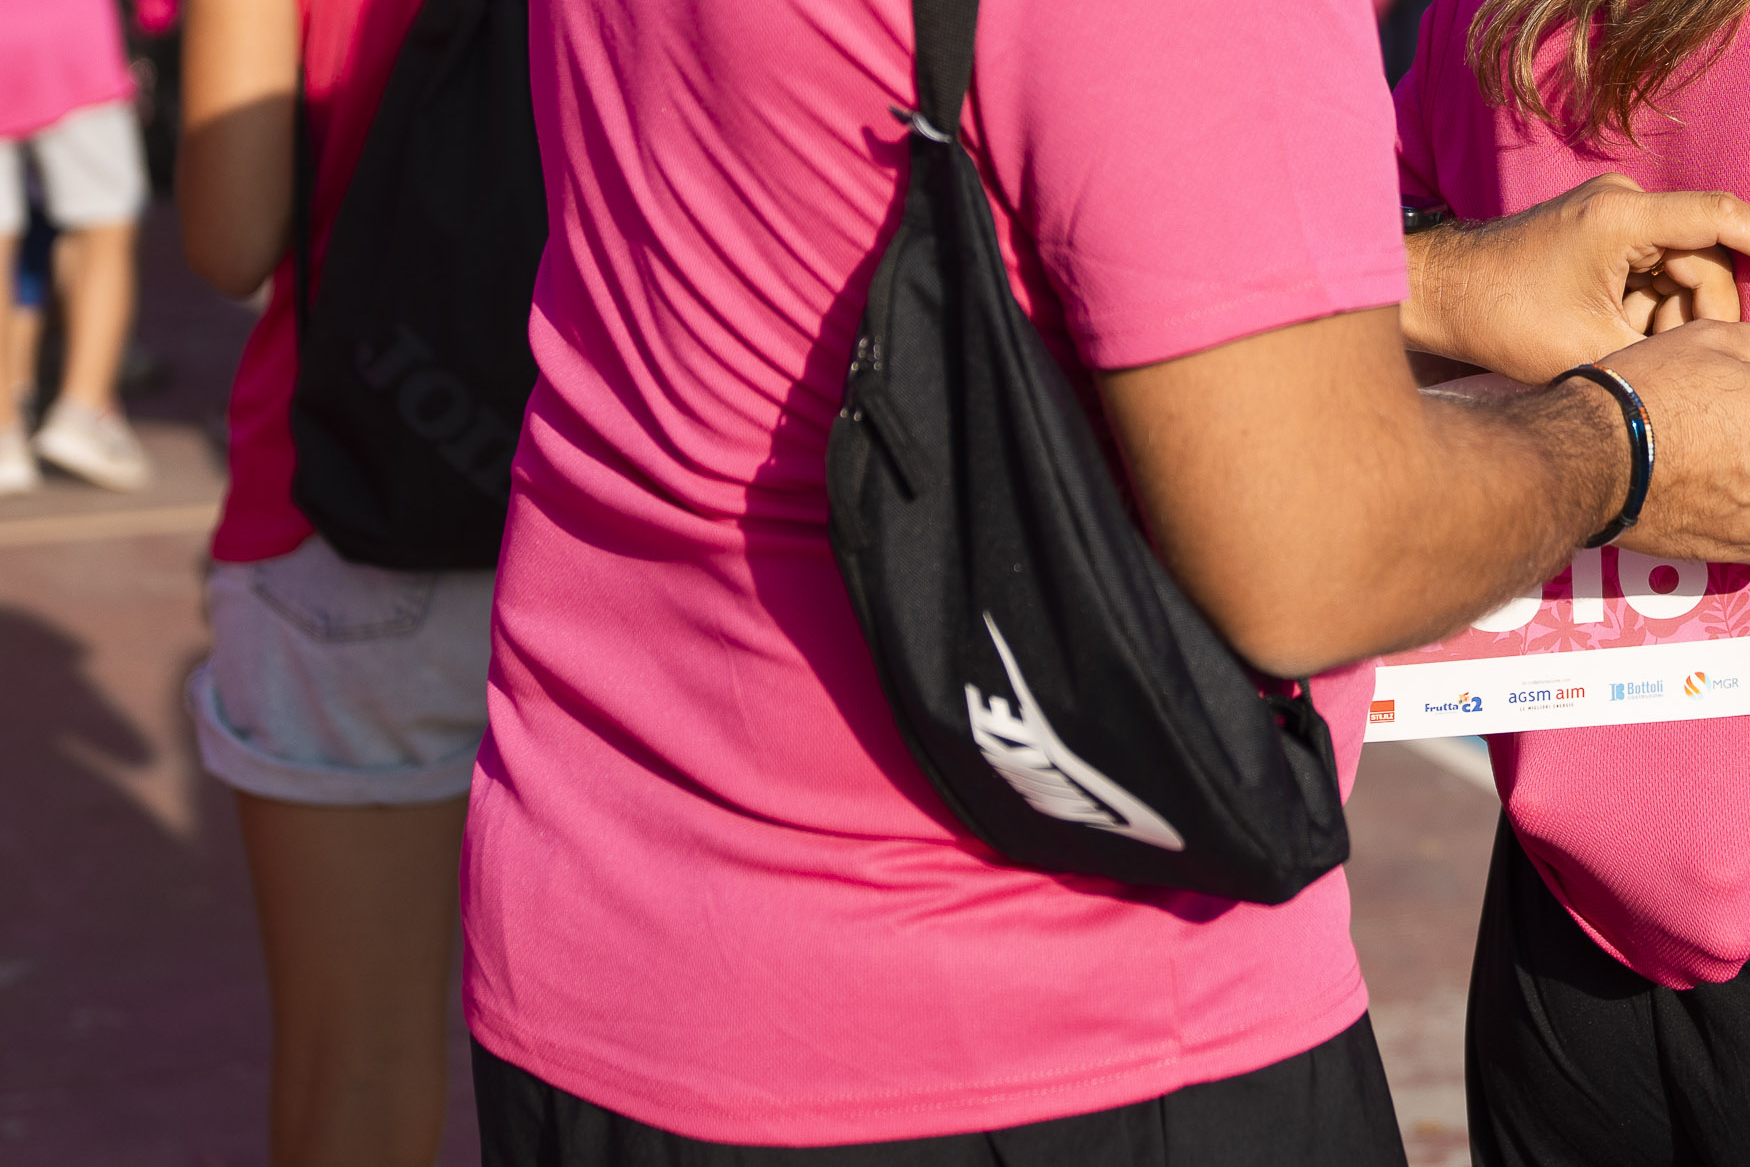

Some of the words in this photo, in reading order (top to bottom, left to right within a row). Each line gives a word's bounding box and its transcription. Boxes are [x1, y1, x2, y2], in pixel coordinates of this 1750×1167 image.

[1627, 681, 1663, 695] Bottoli
[1712, 678, 1739, 689] MGR
[1424, 702, 1459, 712] Frutta
